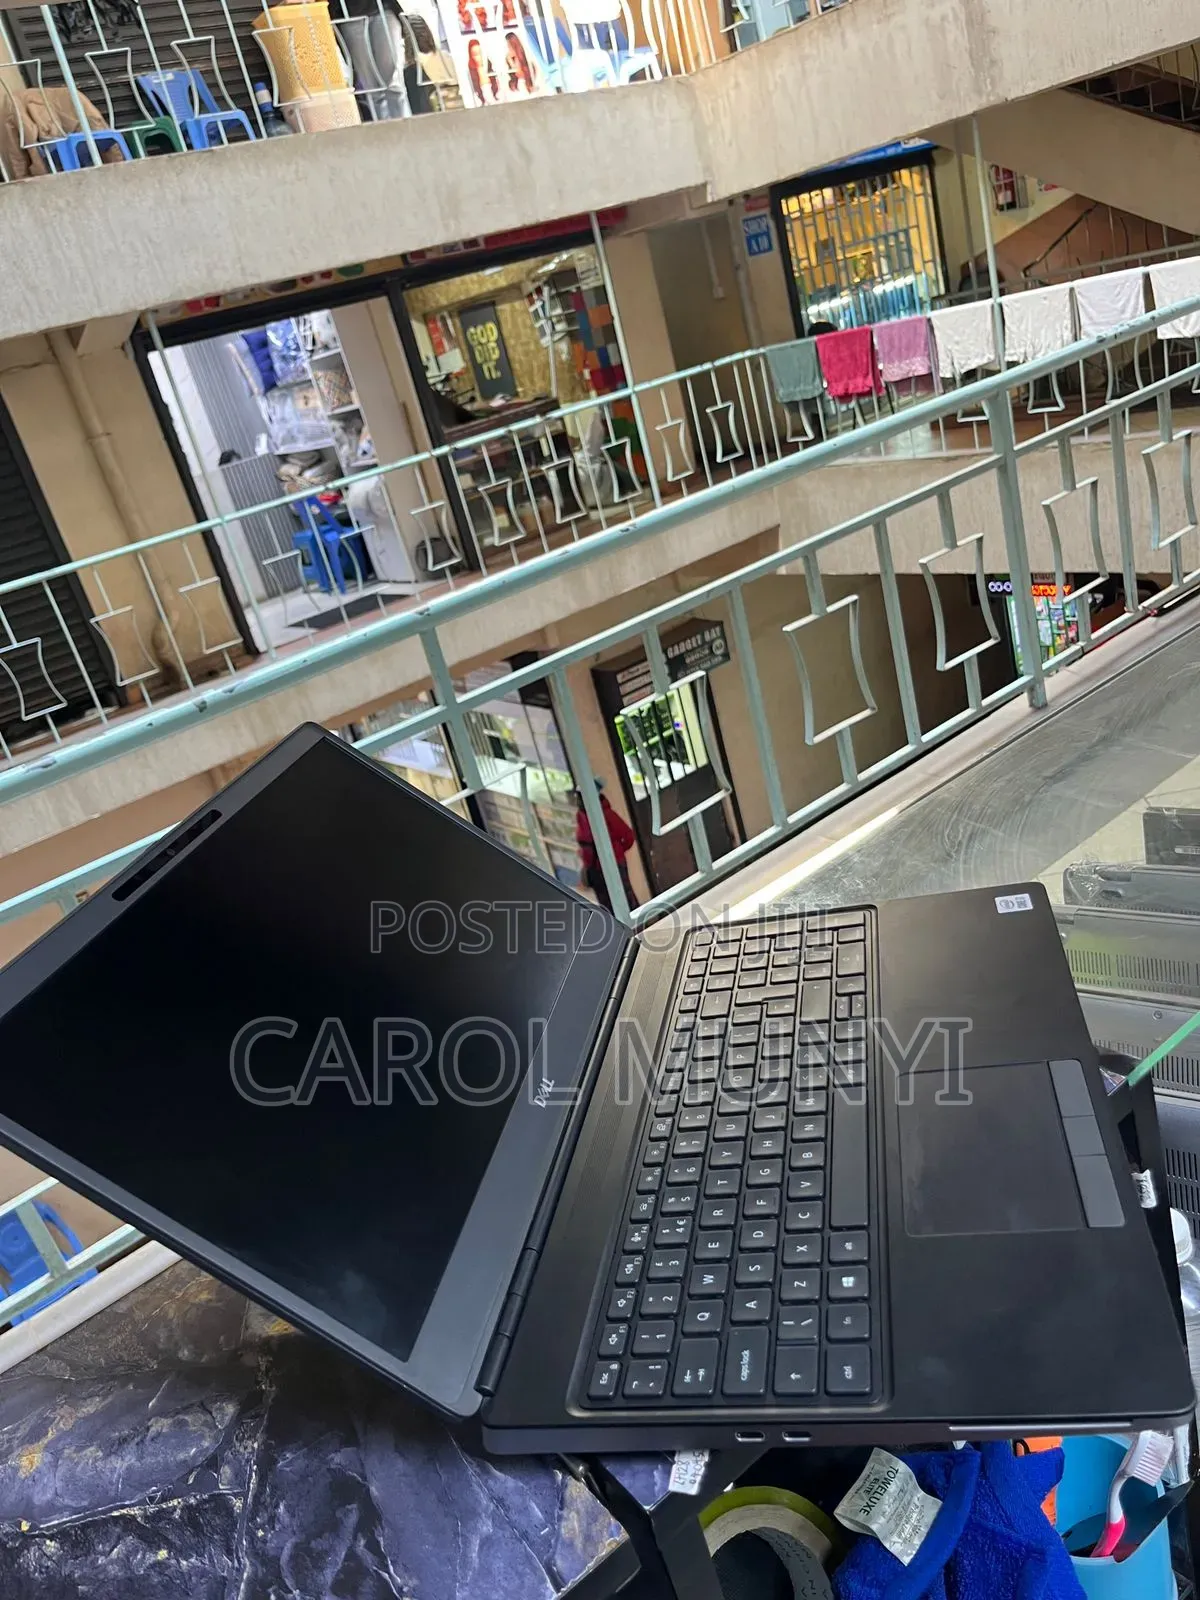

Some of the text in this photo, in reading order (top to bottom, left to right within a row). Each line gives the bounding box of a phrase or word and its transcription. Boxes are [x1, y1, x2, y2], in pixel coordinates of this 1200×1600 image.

[466, 321, 499, 346] GOD
[475, 341, 501, 364] DID
[533, 1077, 555, 1108] DELL
[725, 1123, 736, 1131] U
[762, 1140, 772, 1148] H
[802, 1151, 813, 1159] B
[759, 1168, 771, 1176] G
[712, 1209, 724, 1217] R
[752, 1230, 764, 1238] D
[708, 1241, 720, 1249] E
[796, 1244, 808, 1253] X
[748, 1264, 760, 1272] S
[702, 1274, 715, 1285] W
[794, 1280, 806, 1288] Z
[662, 1294, 673, 1302] 2
[745, 1300, 757, 1309] A
[697, 1311, 711, 1321] Q
[859, 1464, 899, 1516] TOWELUXE
[863, 1478, 880, 1497] ELITE
